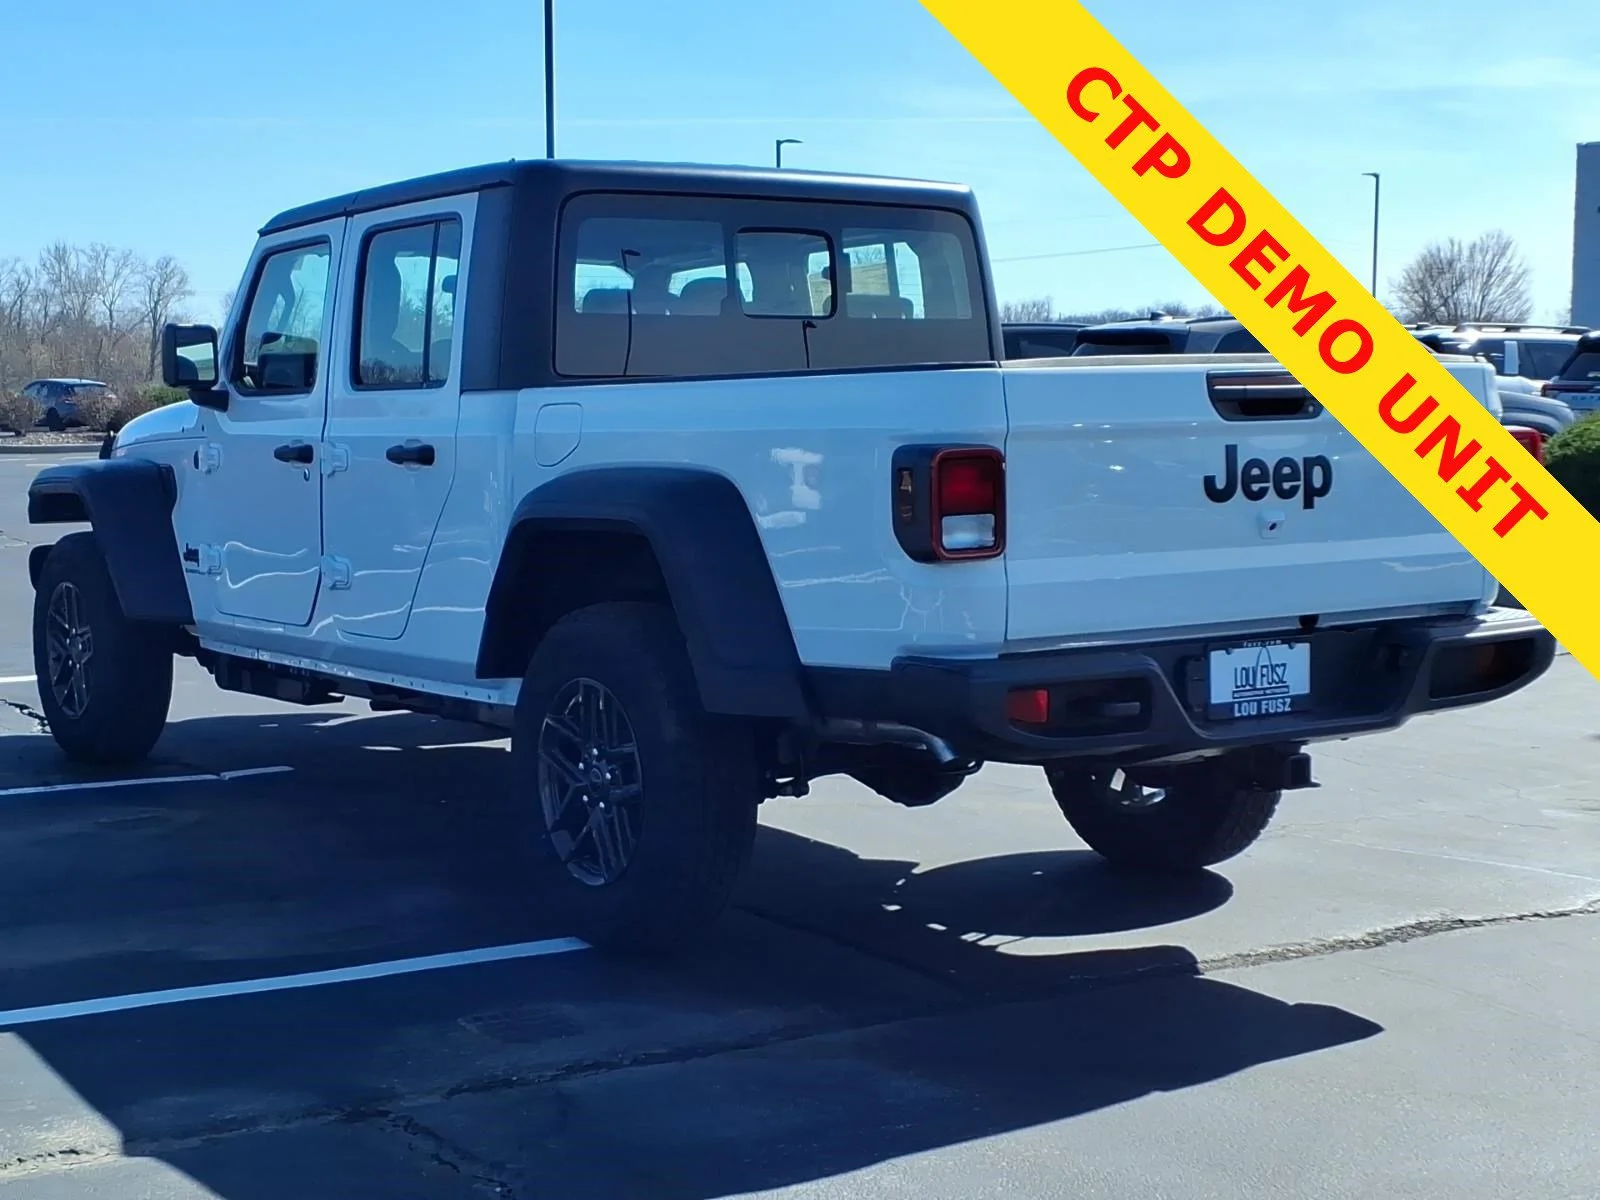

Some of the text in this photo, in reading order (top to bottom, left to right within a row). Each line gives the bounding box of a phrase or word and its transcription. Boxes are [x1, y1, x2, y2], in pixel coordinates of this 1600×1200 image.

[1203, 444, 1333, 510] Jeep
[1235, 663, 1287, 688] LOU FUSZ
[1234, 698, 1292, 717] LOU FUSZ
